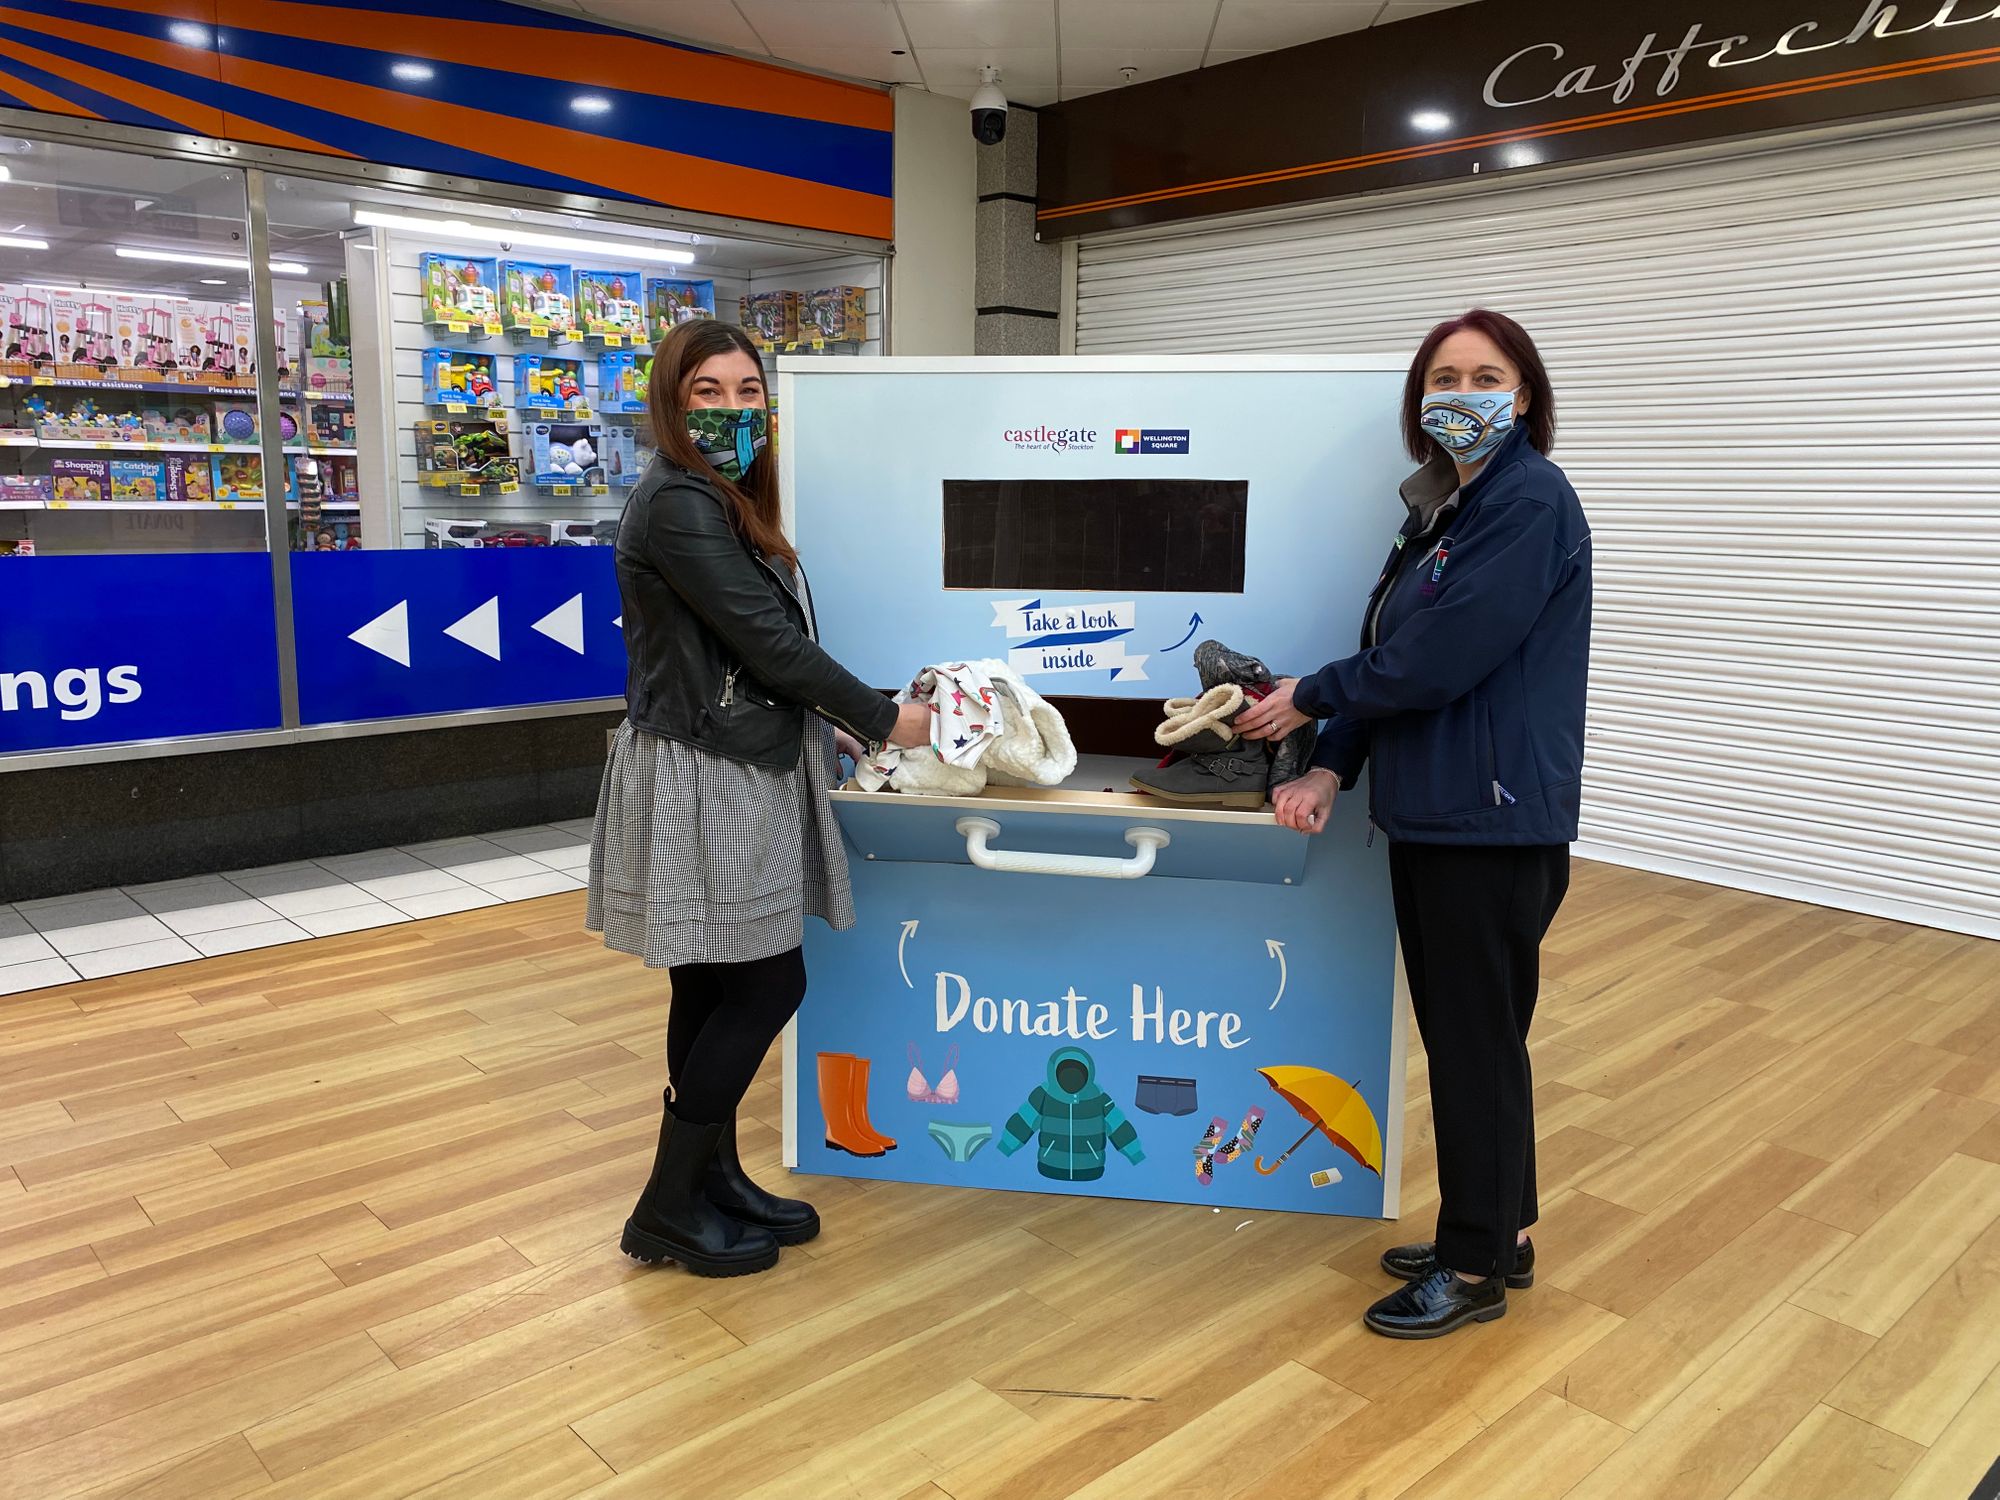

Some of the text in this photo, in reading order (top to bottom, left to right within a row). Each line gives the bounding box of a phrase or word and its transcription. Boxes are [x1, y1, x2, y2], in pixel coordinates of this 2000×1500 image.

[234, 314, 253, 323] Hett
[88, 379, 100, 388] for
[101, 381, 143, 390] assistance
[208, 386, 233, 395] Please
[233, 387, 247, 395] ask
[1004, 425, 1097, 447] castlegate
[65, 461, 104, 471] Shopping
[89, 468, 105, 478] Trip
[123, 462, 160, 473] Catching
[168, 458, 178, 490] Shopping
[1022, 609, 1118, 632] Take a look
[1042, 647, 1097, 669] inside
[0, 665, 142, 721] ngs
[935, 971, 1251, 1049] Donate Here
